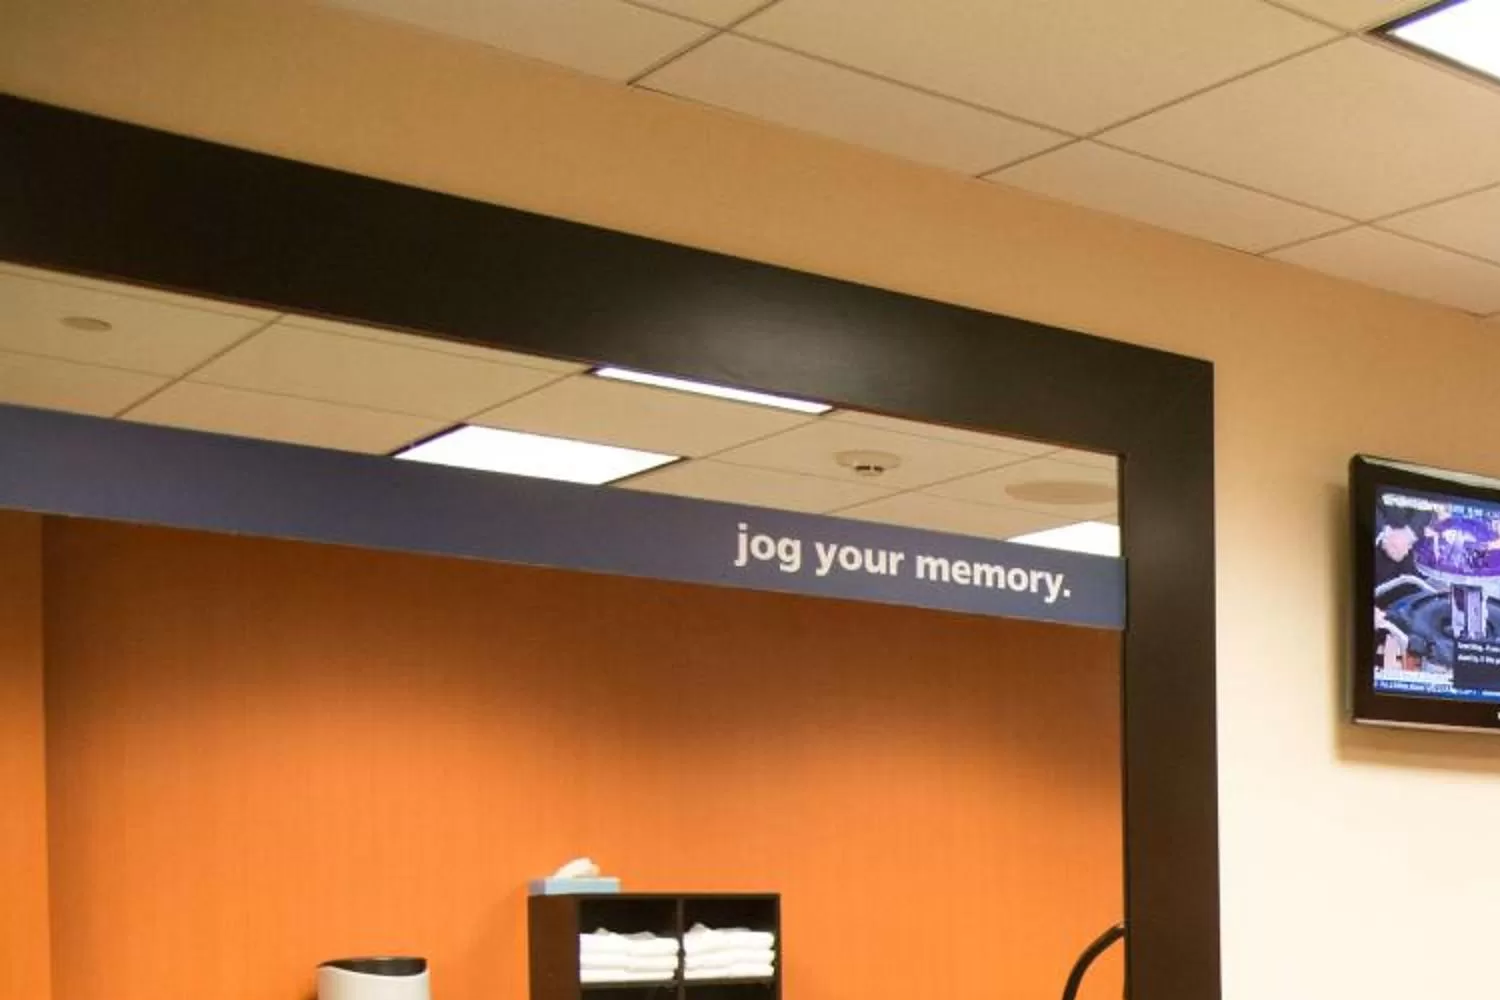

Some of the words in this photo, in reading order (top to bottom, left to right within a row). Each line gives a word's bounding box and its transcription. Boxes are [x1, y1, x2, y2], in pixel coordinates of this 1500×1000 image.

[734, 522, 801, 573] jog
[815, 540, 905, 577] your
[915, 554, 1072, 604] memory.
